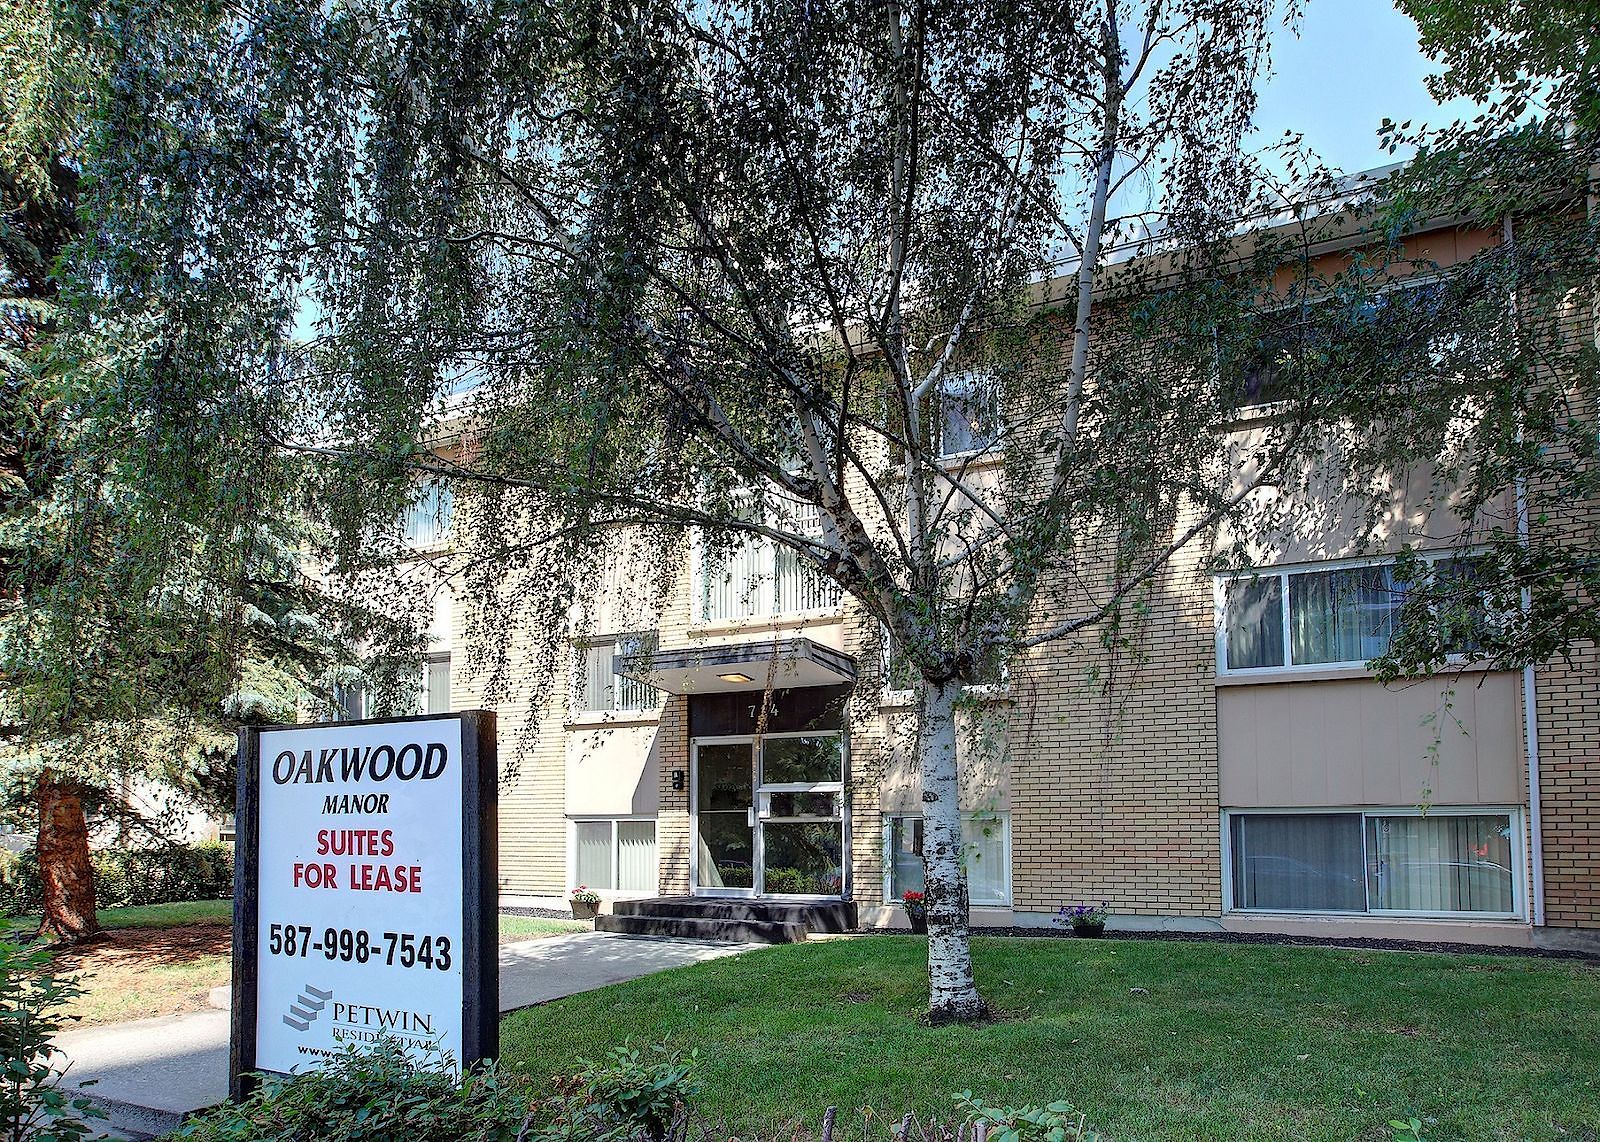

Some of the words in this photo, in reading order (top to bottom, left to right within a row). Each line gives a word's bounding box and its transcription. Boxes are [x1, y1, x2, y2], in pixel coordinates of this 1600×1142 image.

[747, 703, 779, 718] 74
[272, 743, 448, 785] OAKWOOD
[321, 794, 390, 815] MANOR
[316, 829, 394, 857] SUITES
[293, 863, 338, 889] FOR
[350, 864, 422, 893] LEASE
[269, 923, 452, 971] 587-998-7543
[332, 1002, 432, 1033] PETWIN
